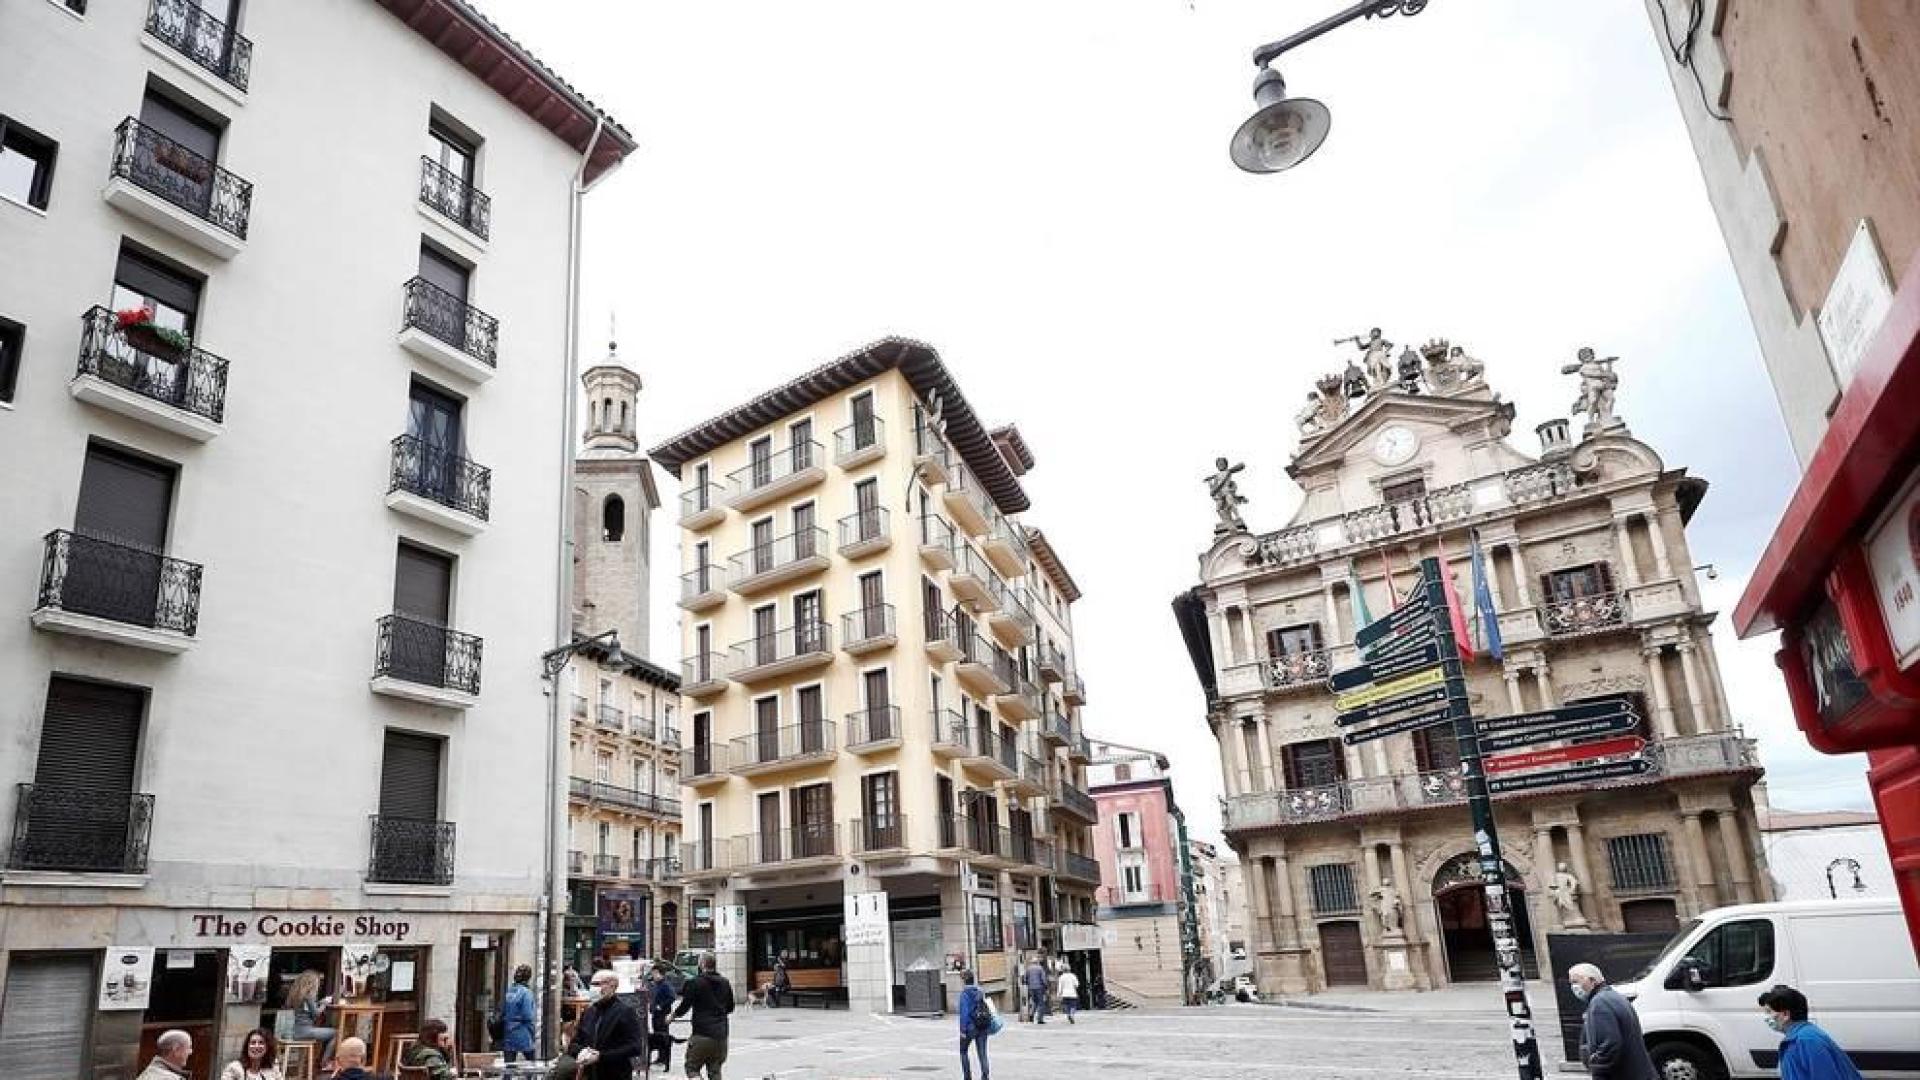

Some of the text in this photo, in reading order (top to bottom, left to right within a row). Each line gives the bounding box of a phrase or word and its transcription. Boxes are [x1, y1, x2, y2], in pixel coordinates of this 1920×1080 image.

[193, 914, 411, 941] The Cookie Shop
